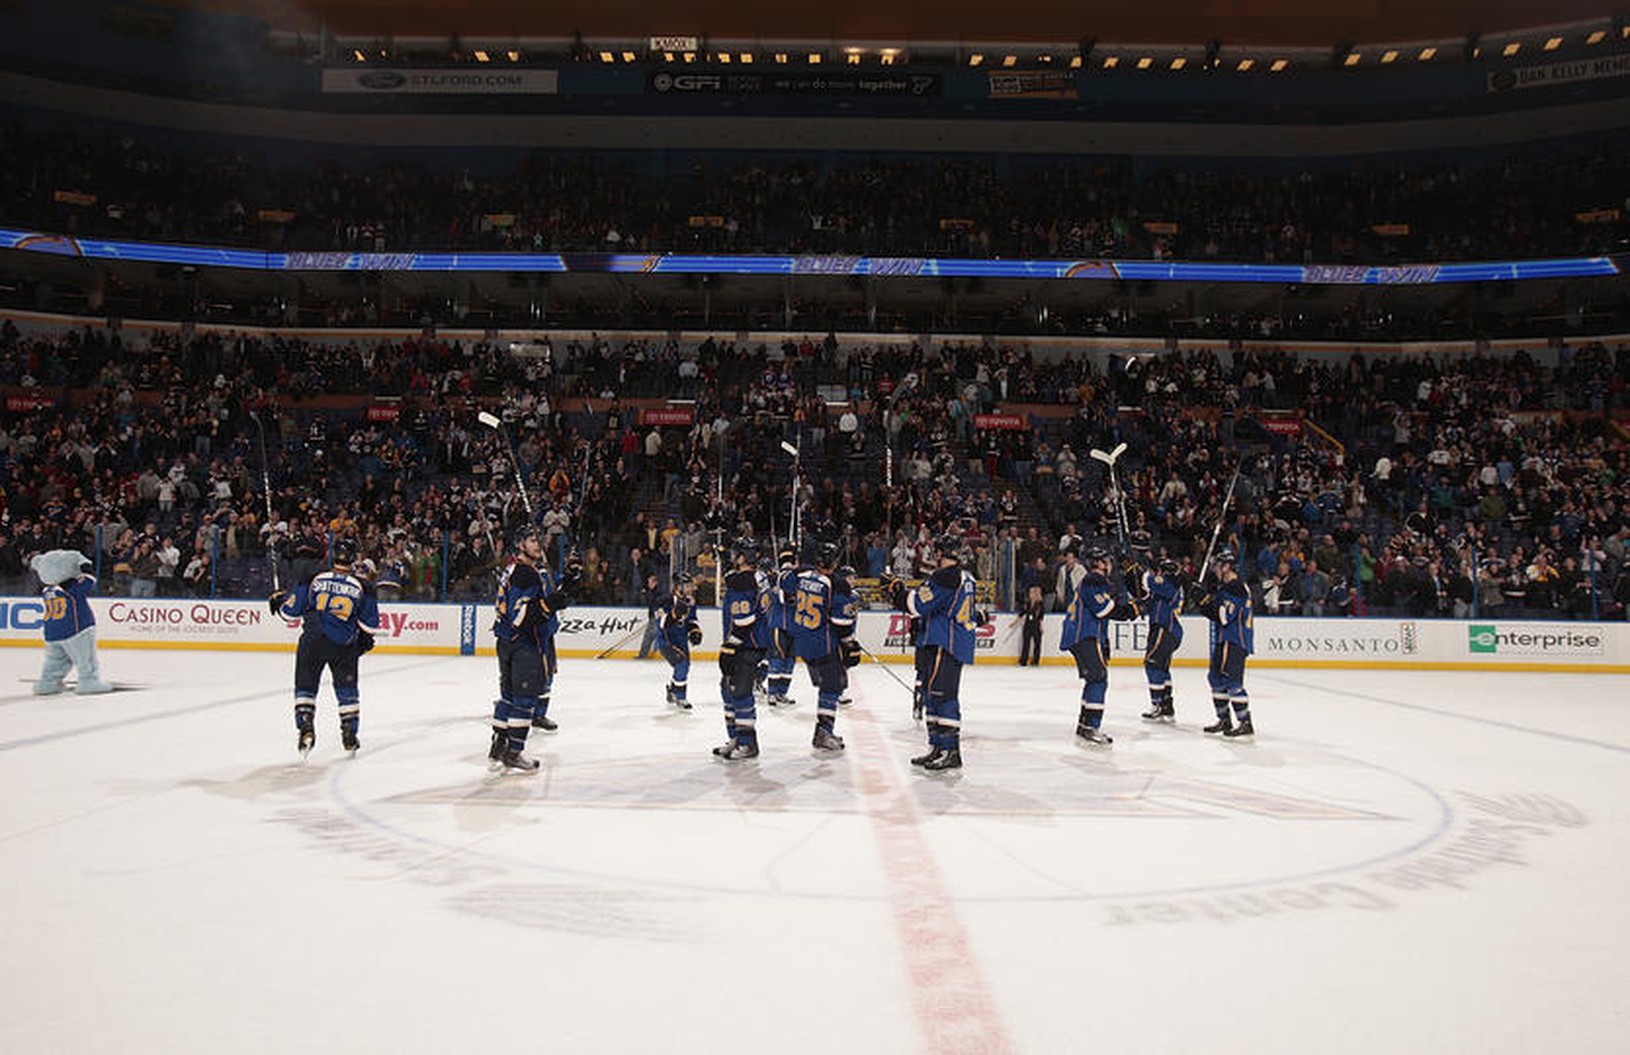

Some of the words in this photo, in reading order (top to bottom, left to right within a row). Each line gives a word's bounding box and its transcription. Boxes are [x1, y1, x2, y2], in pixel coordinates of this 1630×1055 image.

[285, 252, 348, 271] BLUES
[359, 253, 415, 271] WIN
[793, 257, 860, 274] BLUES
[869, 257, 926, 275] WIN
[1303, 265, 1369, 283] BLUES
[1377, 265, 1439, 283] WIN
[109, 602, 184, 624] CASINO
[190, 603, 262, 625] QUEEN
[795, 590, 825, 629] 25
[599, 617, 642, 635] Hut
[1268, 637, 1399, 654] MONSANTO
[1476, 630, 1601, 650] enterprise
